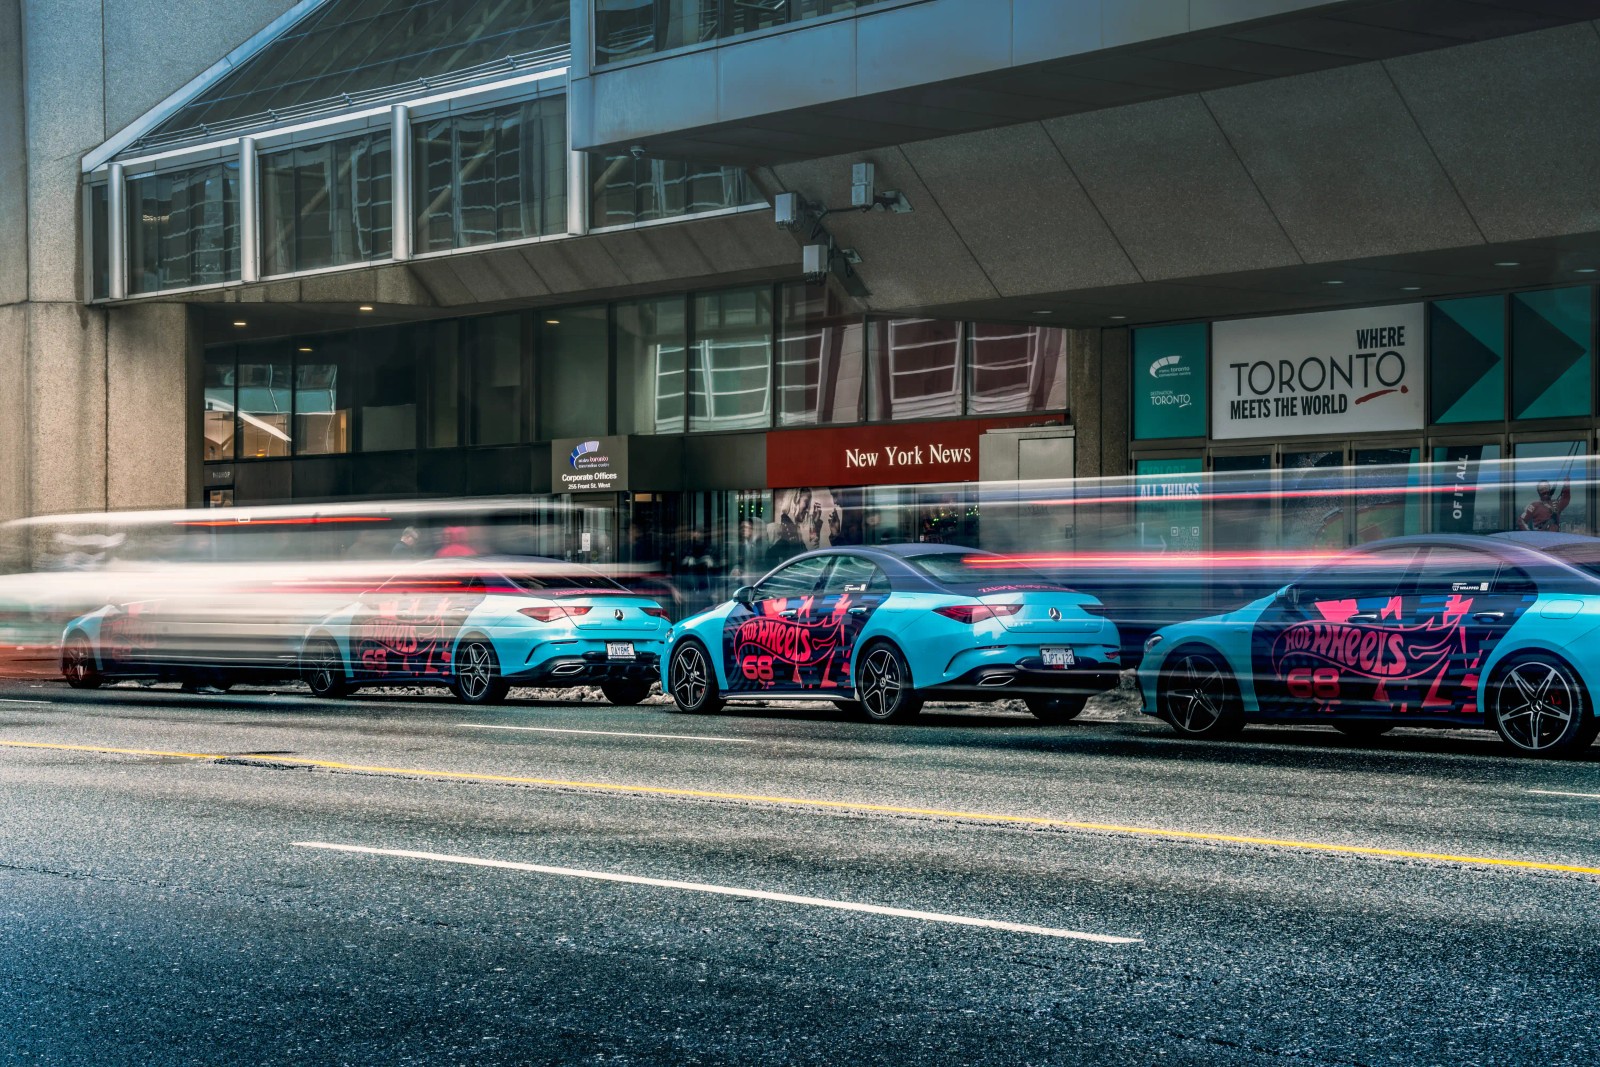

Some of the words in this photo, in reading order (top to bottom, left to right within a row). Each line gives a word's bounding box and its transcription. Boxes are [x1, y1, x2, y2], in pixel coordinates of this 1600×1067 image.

[1356, 326, 1405, 350] WHERE
[1230, 350, 1406, 396] TORONTO
[1150, 393, 1191, 406] TORONTO
[1230, 396, 1271, 420] MEETS
[1274, 396, 1298, 417] THE
[1301, 393, 1348, 416] WORLD
[845, 448, 879, 468] New
[884, 445, 924, 466] York
[929, 443, 972, 464] News
[1456, 454, 1469, 480] ALL
[562, 473, 593, 482] Corporate
[594, 472, 617, 480] Offices
[1140, 484, 1157, 498] ALL
[1161, 483, 1200, 498] THINGS
[1454, 483, 1464, 497] IT
[1453, 501, 1462, 519] OF
[362, 649, 388, 670] 68
[742, 655, 774, 680] 68
[1287, 667, 1340, 698] 68
